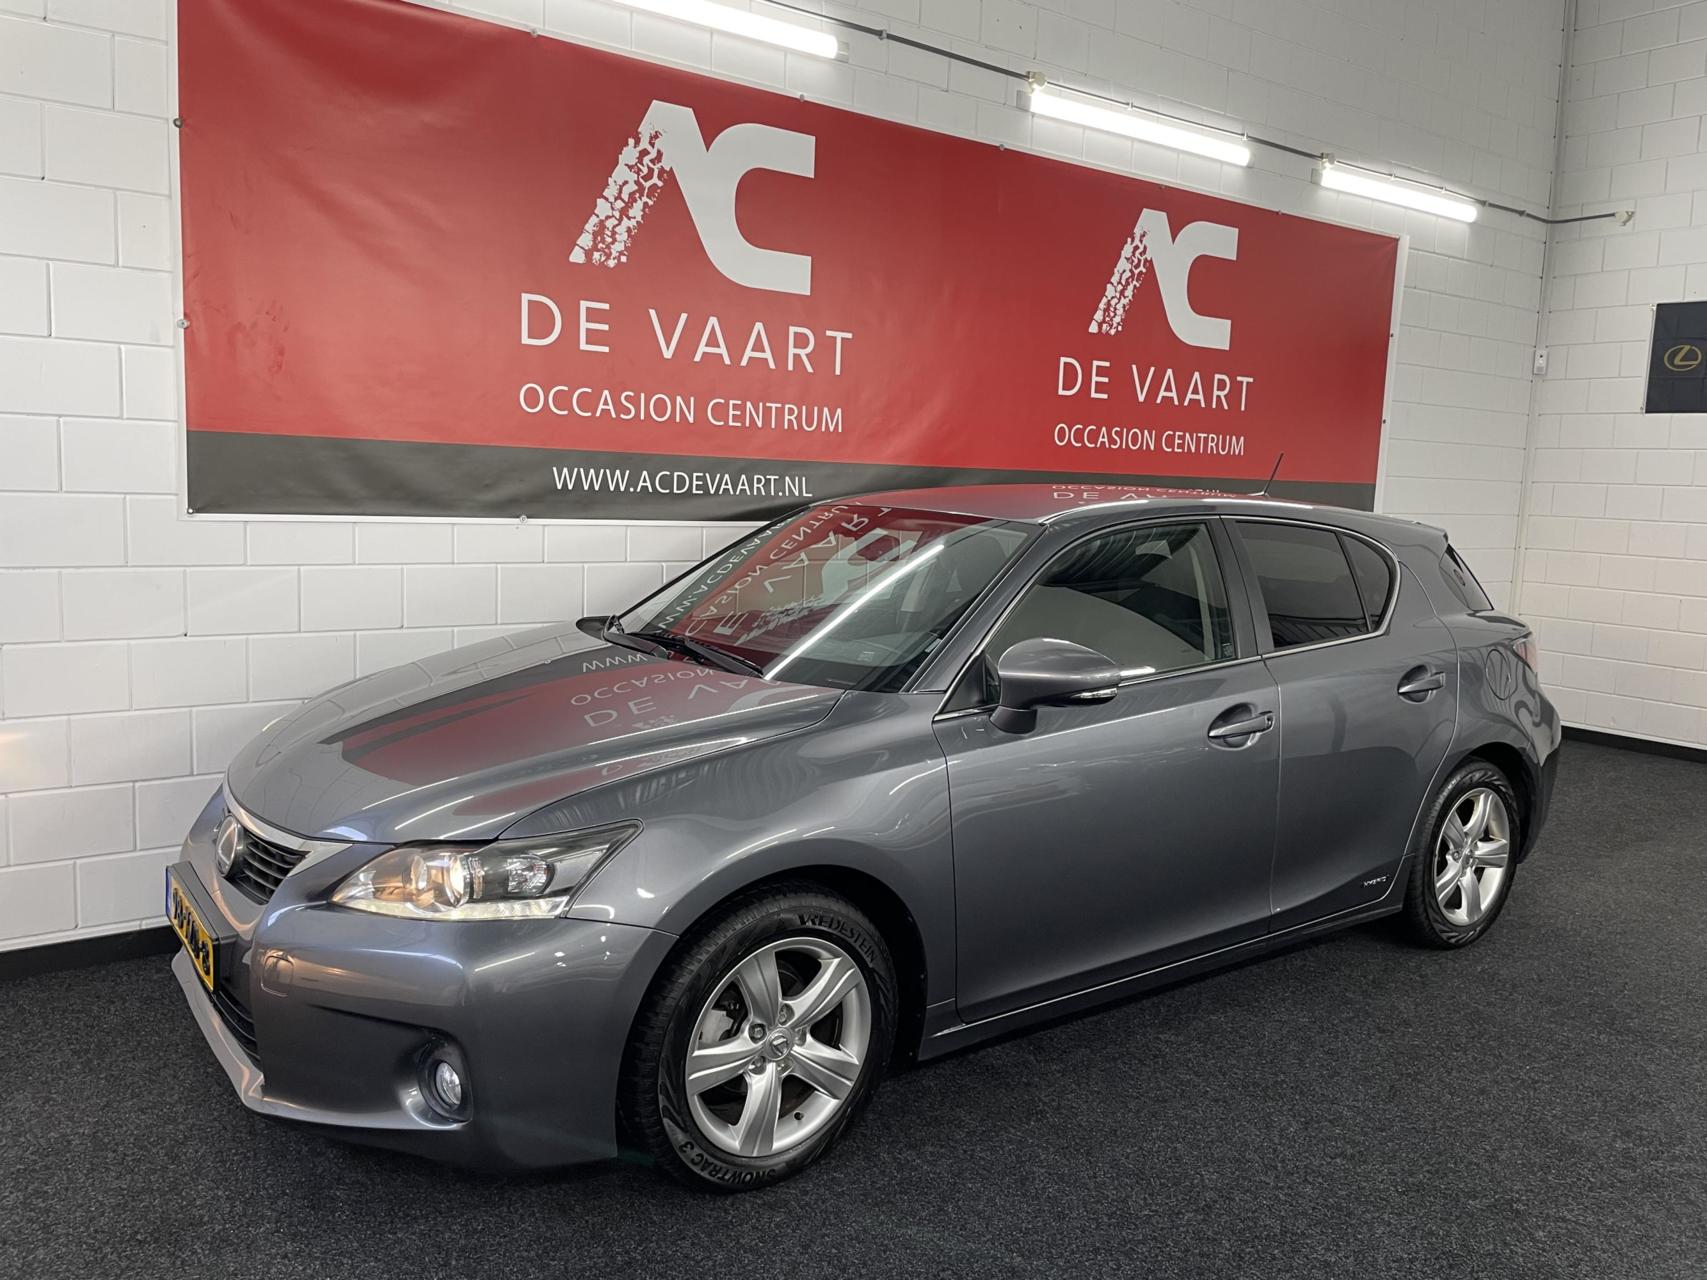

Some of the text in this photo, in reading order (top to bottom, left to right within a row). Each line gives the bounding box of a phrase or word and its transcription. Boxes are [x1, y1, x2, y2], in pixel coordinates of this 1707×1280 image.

[569, 100, 816, 296] AC
[1088, 208, 1239, 351] AC
[520, 292, 853, 375] DE VAART
[519, 383, 843, 433] OCCASION CENTRUM
[1057, 357, 1254, 412] DE VAART
[1054, 423, 1245, 456] OCCASION CENTRUM
[552, 467, 813, 497] WWW.ACDEVAART.NL
